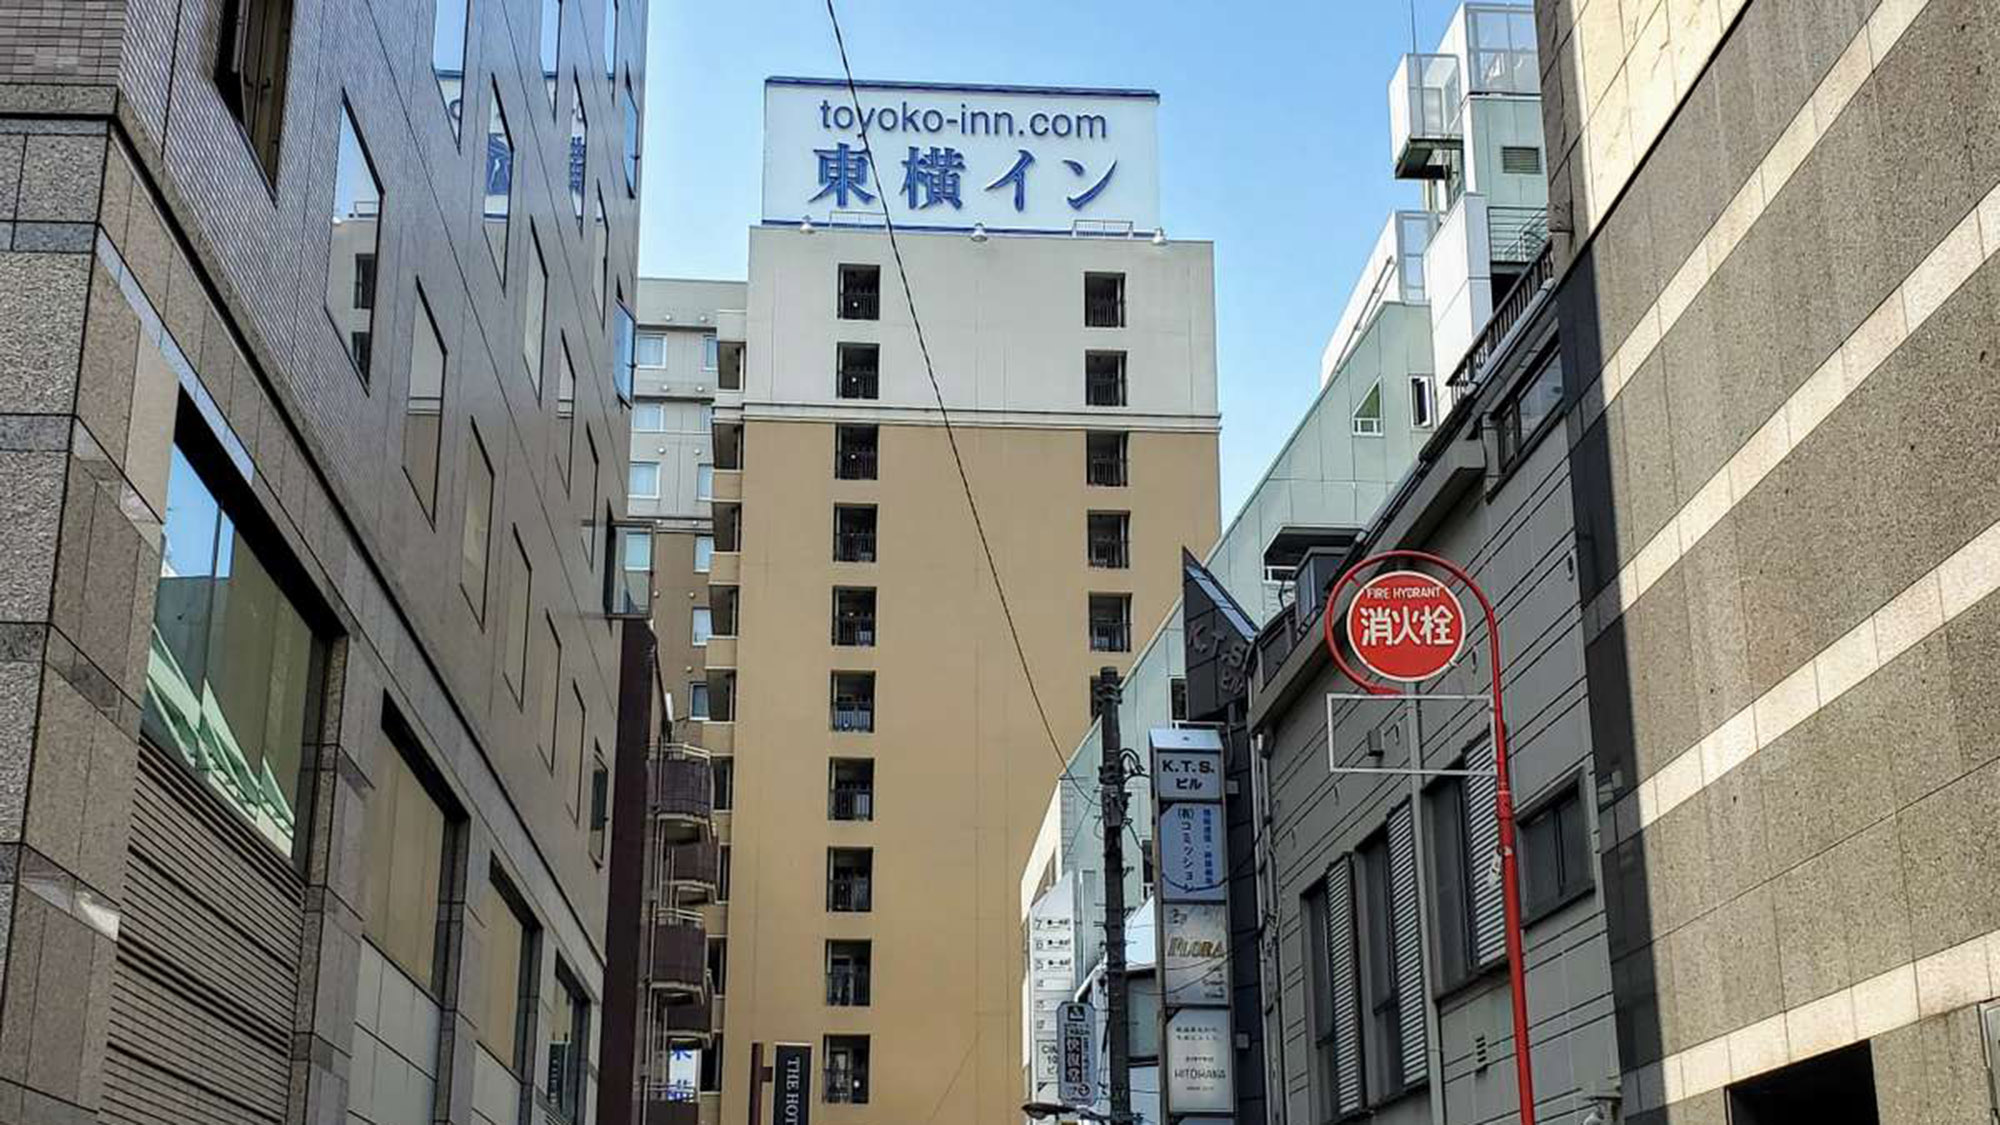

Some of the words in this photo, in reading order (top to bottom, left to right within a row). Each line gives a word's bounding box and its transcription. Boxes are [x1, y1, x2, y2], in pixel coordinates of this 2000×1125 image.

[819, 98, 1108, 139] toyoko-inn.com
[808, 142, 1119, 212] 東横イン
[1366, 586, 1389, 600] FIRE
[1392, 586, 1441, 600] HYDRANT
[1360, 605, 1455, 647] 消火栓
[1162, 759, 1215, 774] K.T.S.
[1175, 777, 1203, 791] ビル
[786, 1056, 801, 1090] THE
